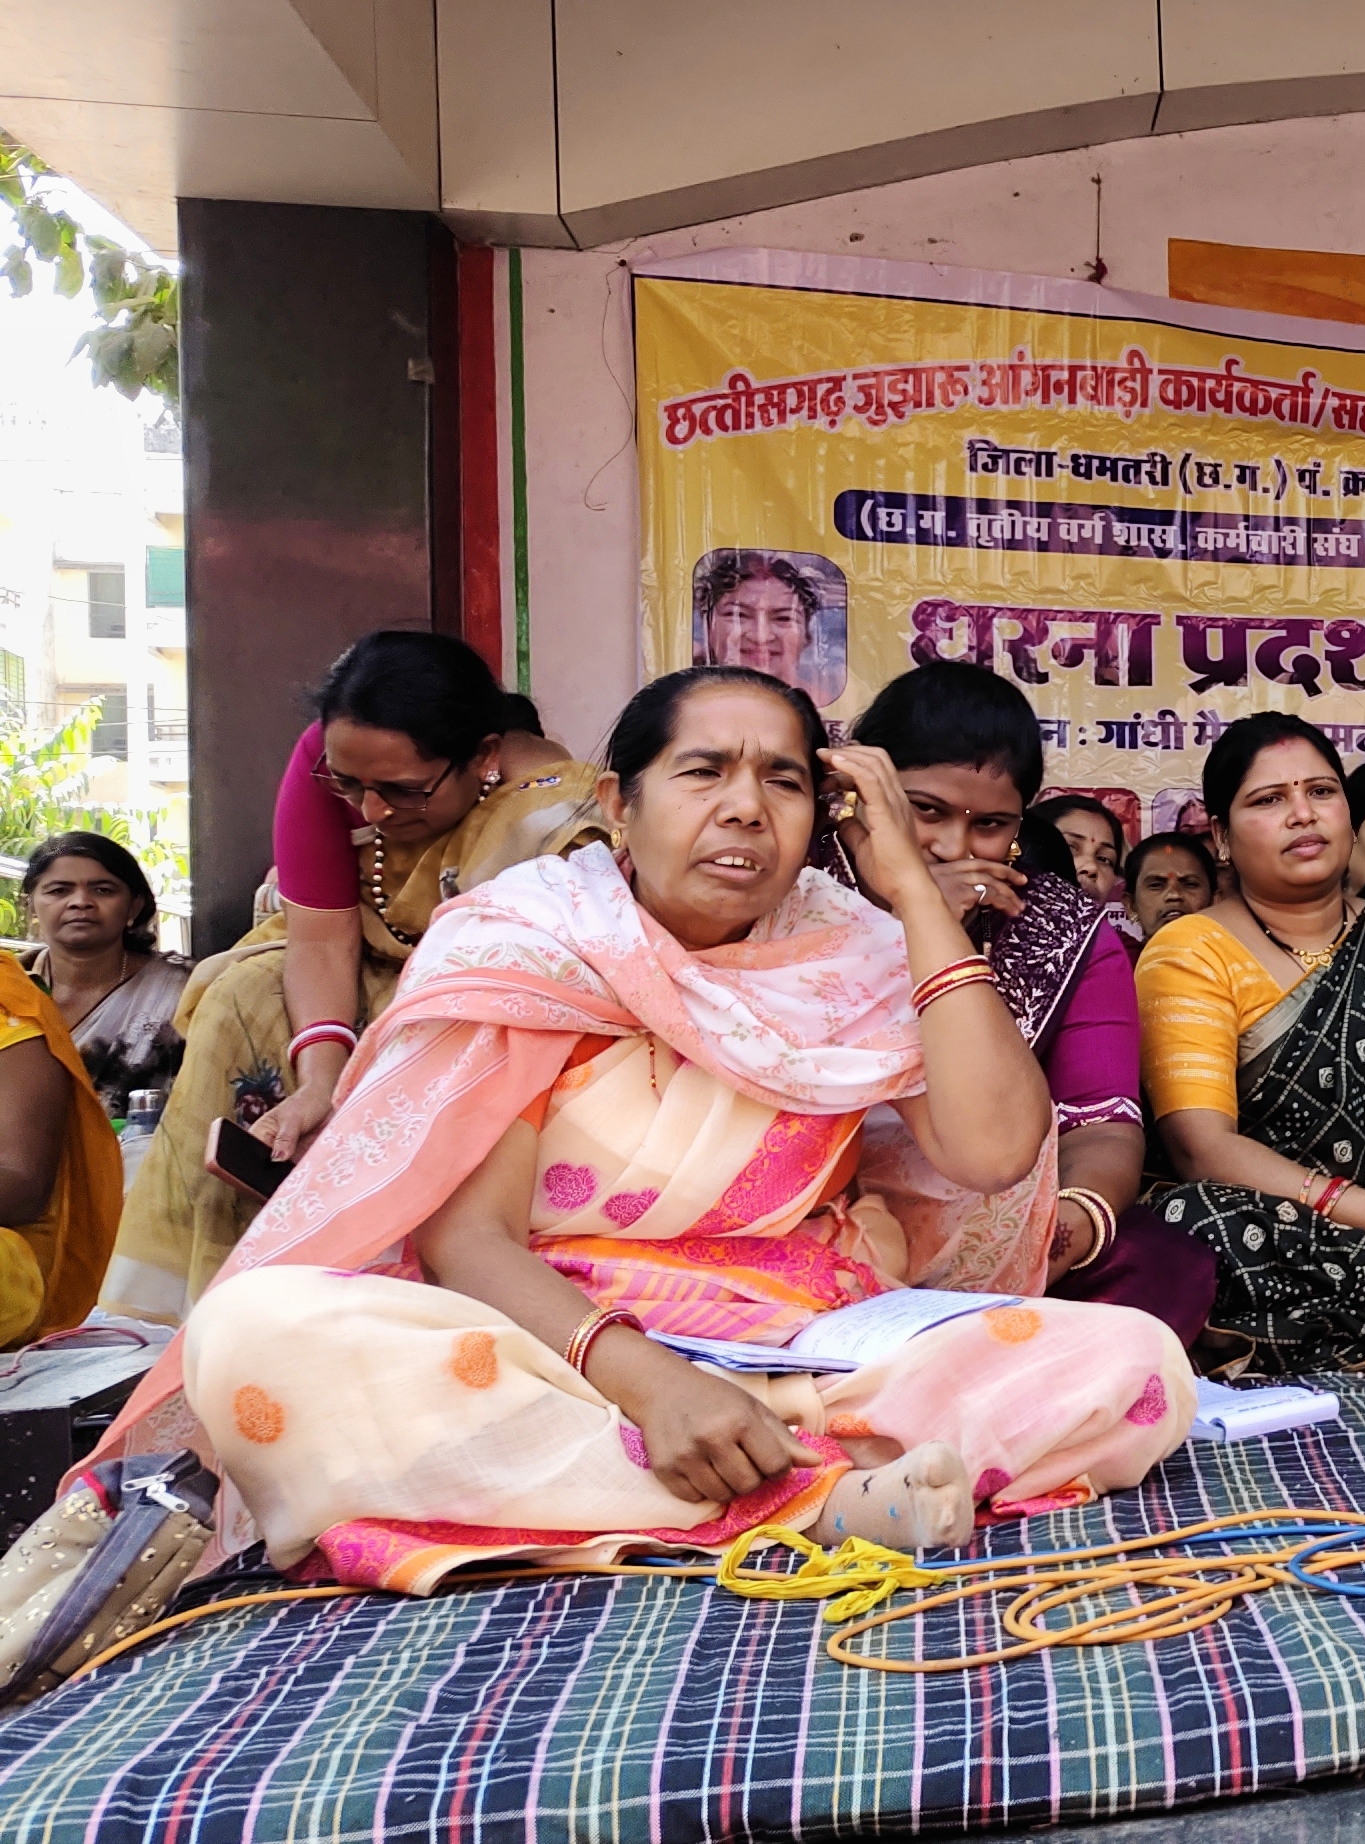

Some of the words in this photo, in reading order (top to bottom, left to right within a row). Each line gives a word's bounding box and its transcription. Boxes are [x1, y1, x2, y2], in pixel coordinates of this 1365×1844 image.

[664, 373, 846, 446] छत्तीसगढ़
[853, 362, 973, 427] जुझारू
[976, 347, 1151, 420] आंगनबाड़ी
[968, 441, 1170, 487] जिला-धमतरी
[1179, 452, 1287, 500] (छ.ग.)
[967, 507, 1051, 548] तृतीय
[1058, 511, 1105, 545] वर्ग
[1112, 520, 1187, 551] शास.
[1197, 522, 1307, 556] कर्मचारी
[1313, 528, 1360, 558] संघ
[909, 598, 1161, 687] धरना
[1096, 709, 1187, 750] गांधी
